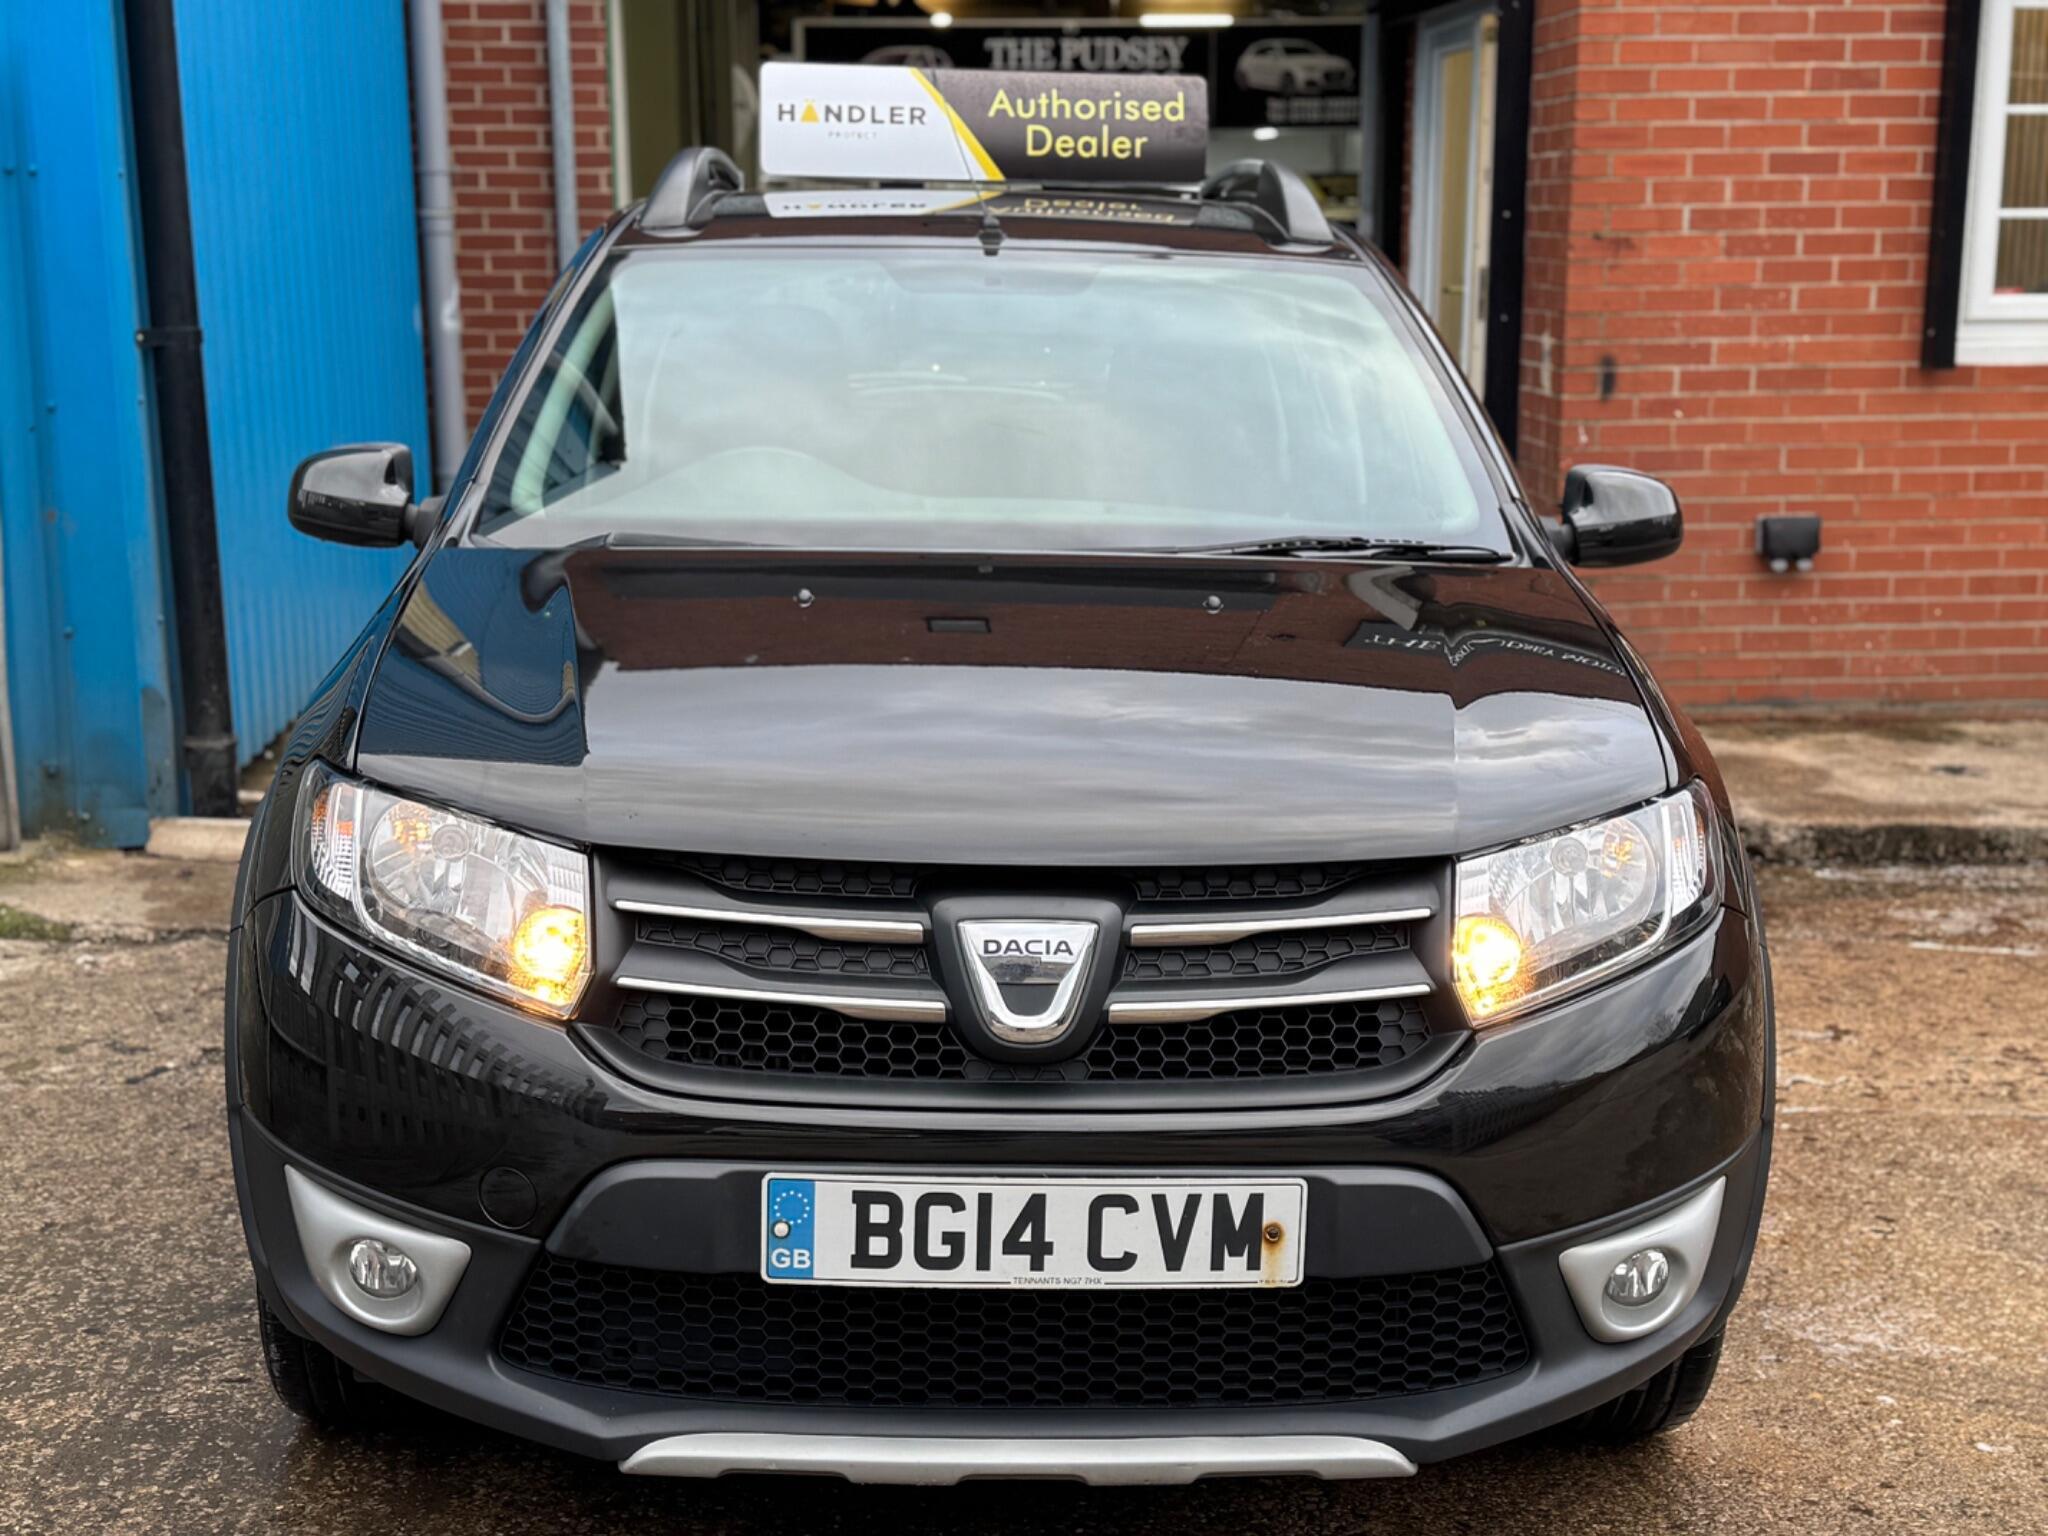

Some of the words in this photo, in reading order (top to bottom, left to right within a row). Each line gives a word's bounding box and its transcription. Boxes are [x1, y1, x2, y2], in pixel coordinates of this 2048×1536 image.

[984, 36, 1056, 71] THE
[1059, 36, 1190, 73] PUDSEY
[988, 89, 1185, 121] Authorised
[1026, 124, 1148, 159] Dealer
[984, 939, 1073, 956] DACIA
[851, 1190, 1054, 1271] BG14
[1087, 1193, 1264, 1271] CVM
[771, 1248, 811, 1269] GB
[1013, 1276, 1061, 1285] TENNANTS
